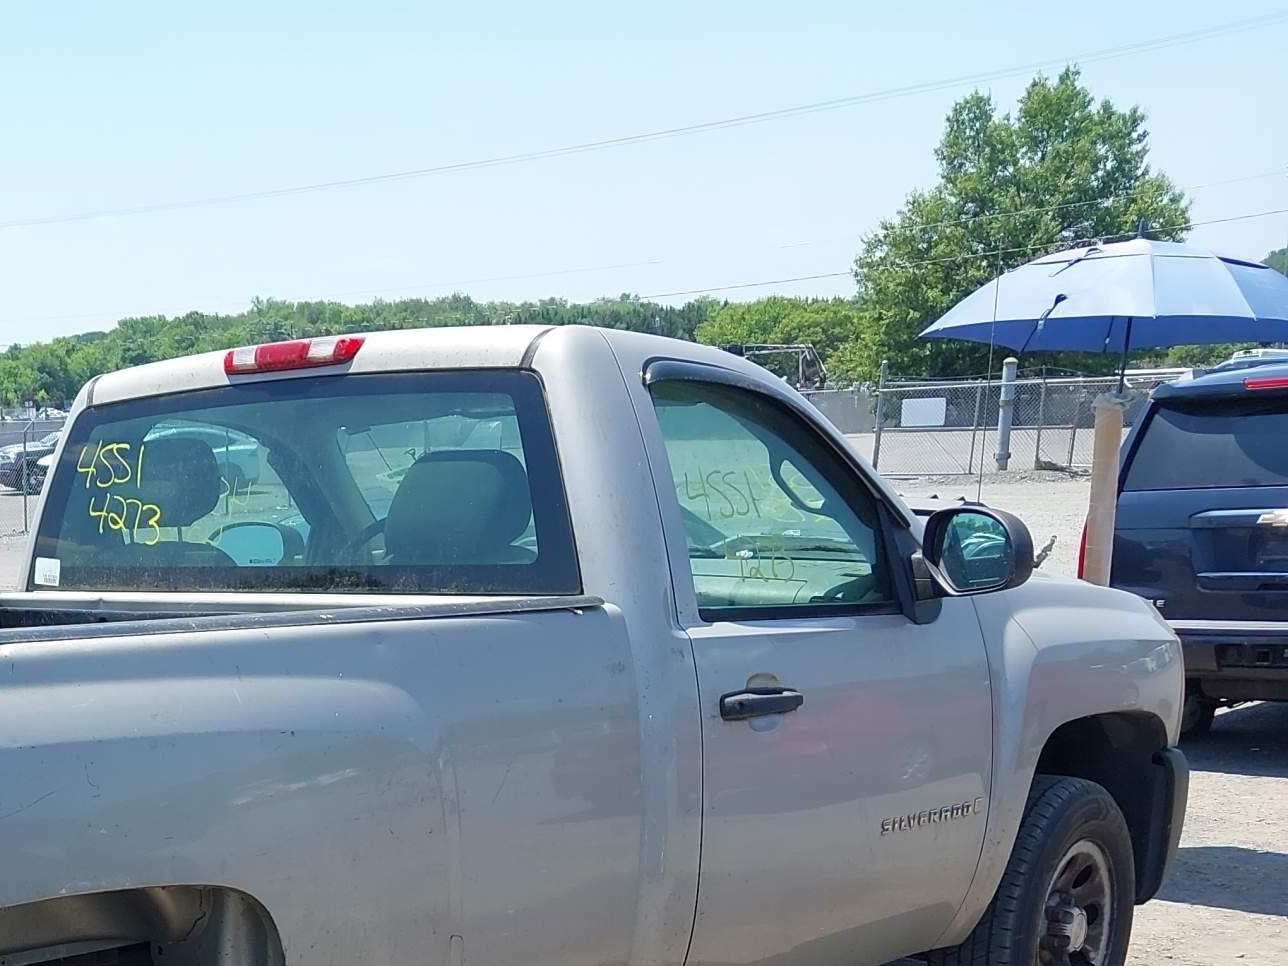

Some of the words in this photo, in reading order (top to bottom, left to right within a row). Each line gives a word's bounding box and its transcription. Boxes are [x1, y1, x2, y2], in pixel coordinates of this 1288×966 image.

[76, 439, 145, 489] 4551
[88, 492, 161, 545] 4273
[684, 464, 762, 520] 4551
